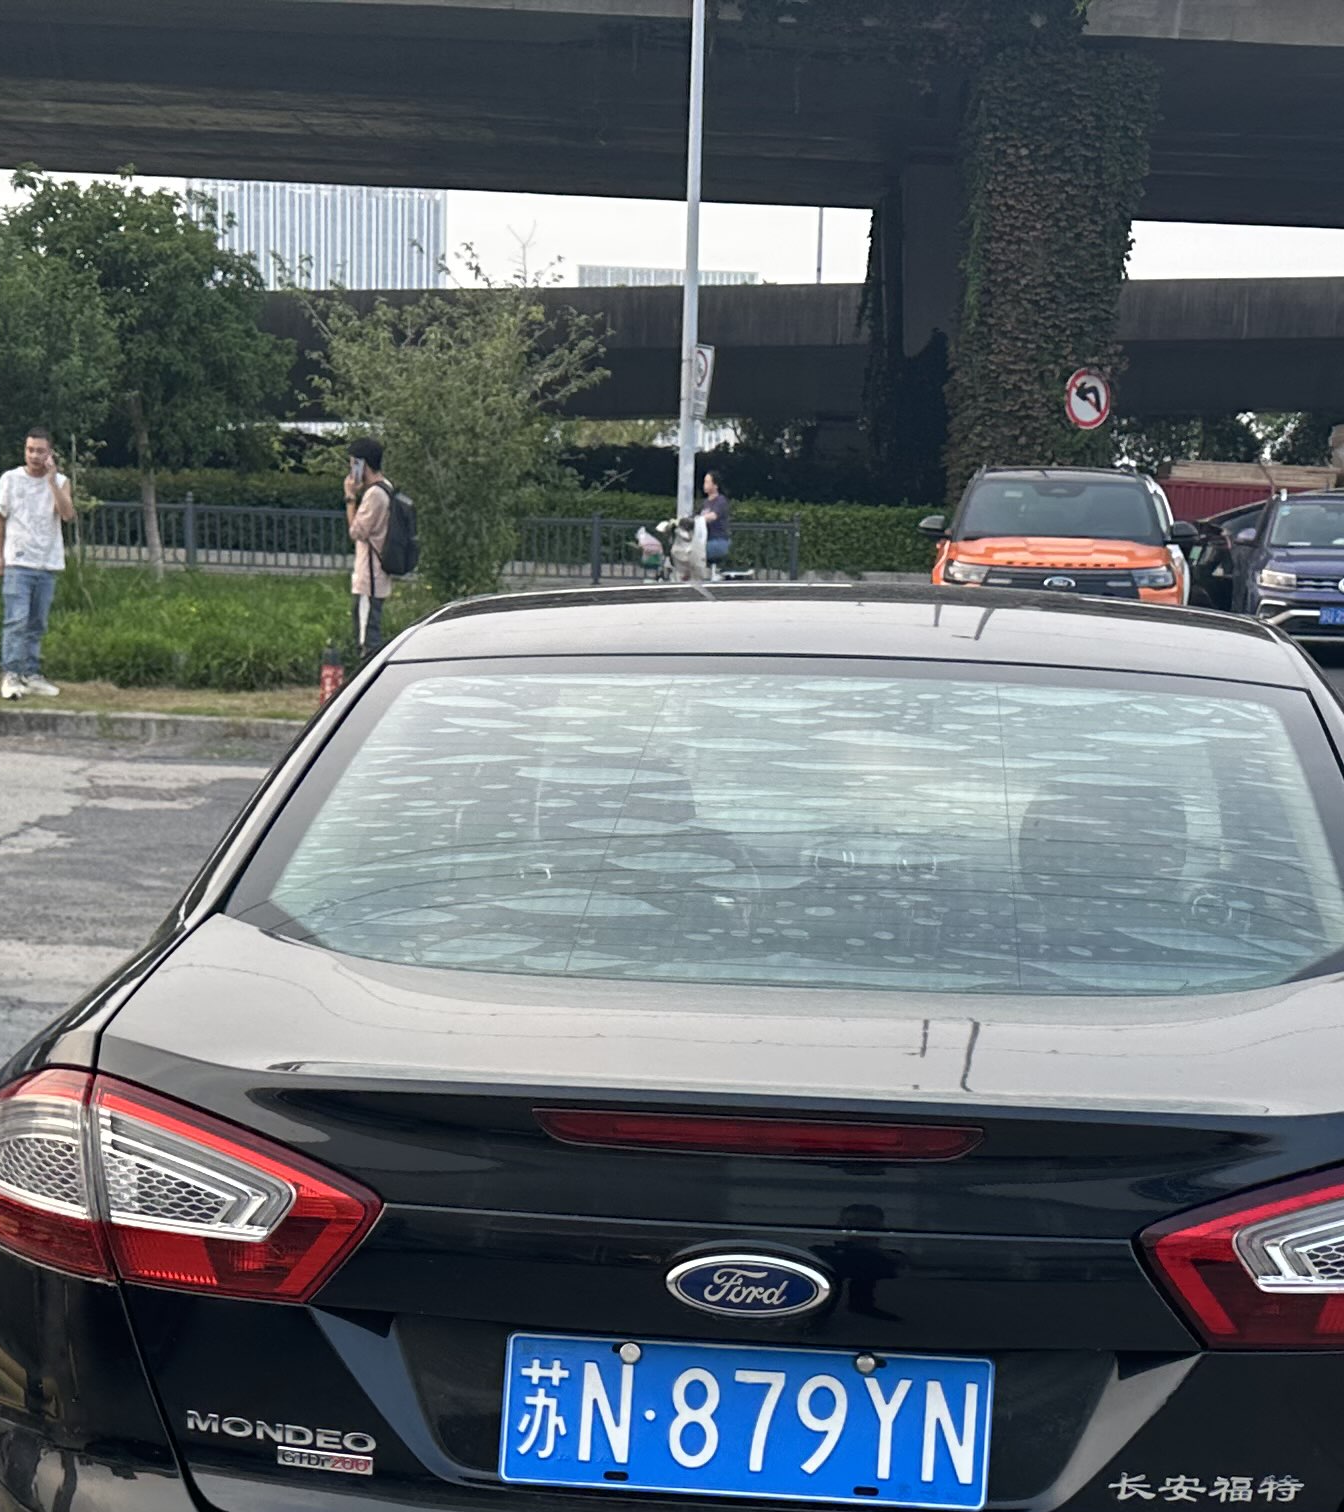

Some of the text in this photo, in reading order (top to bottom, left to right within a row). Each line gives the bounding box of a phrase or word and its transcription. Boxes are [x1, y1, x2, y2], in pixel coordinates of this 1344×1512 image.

[703, 1268, 789, 1305] Ford
[186, 1410, 377, 1452] MONDEO
[516, 1359, 978, 1485] 苏N·879YN
[1107, 1472, 1305, 1502] 长安福特
